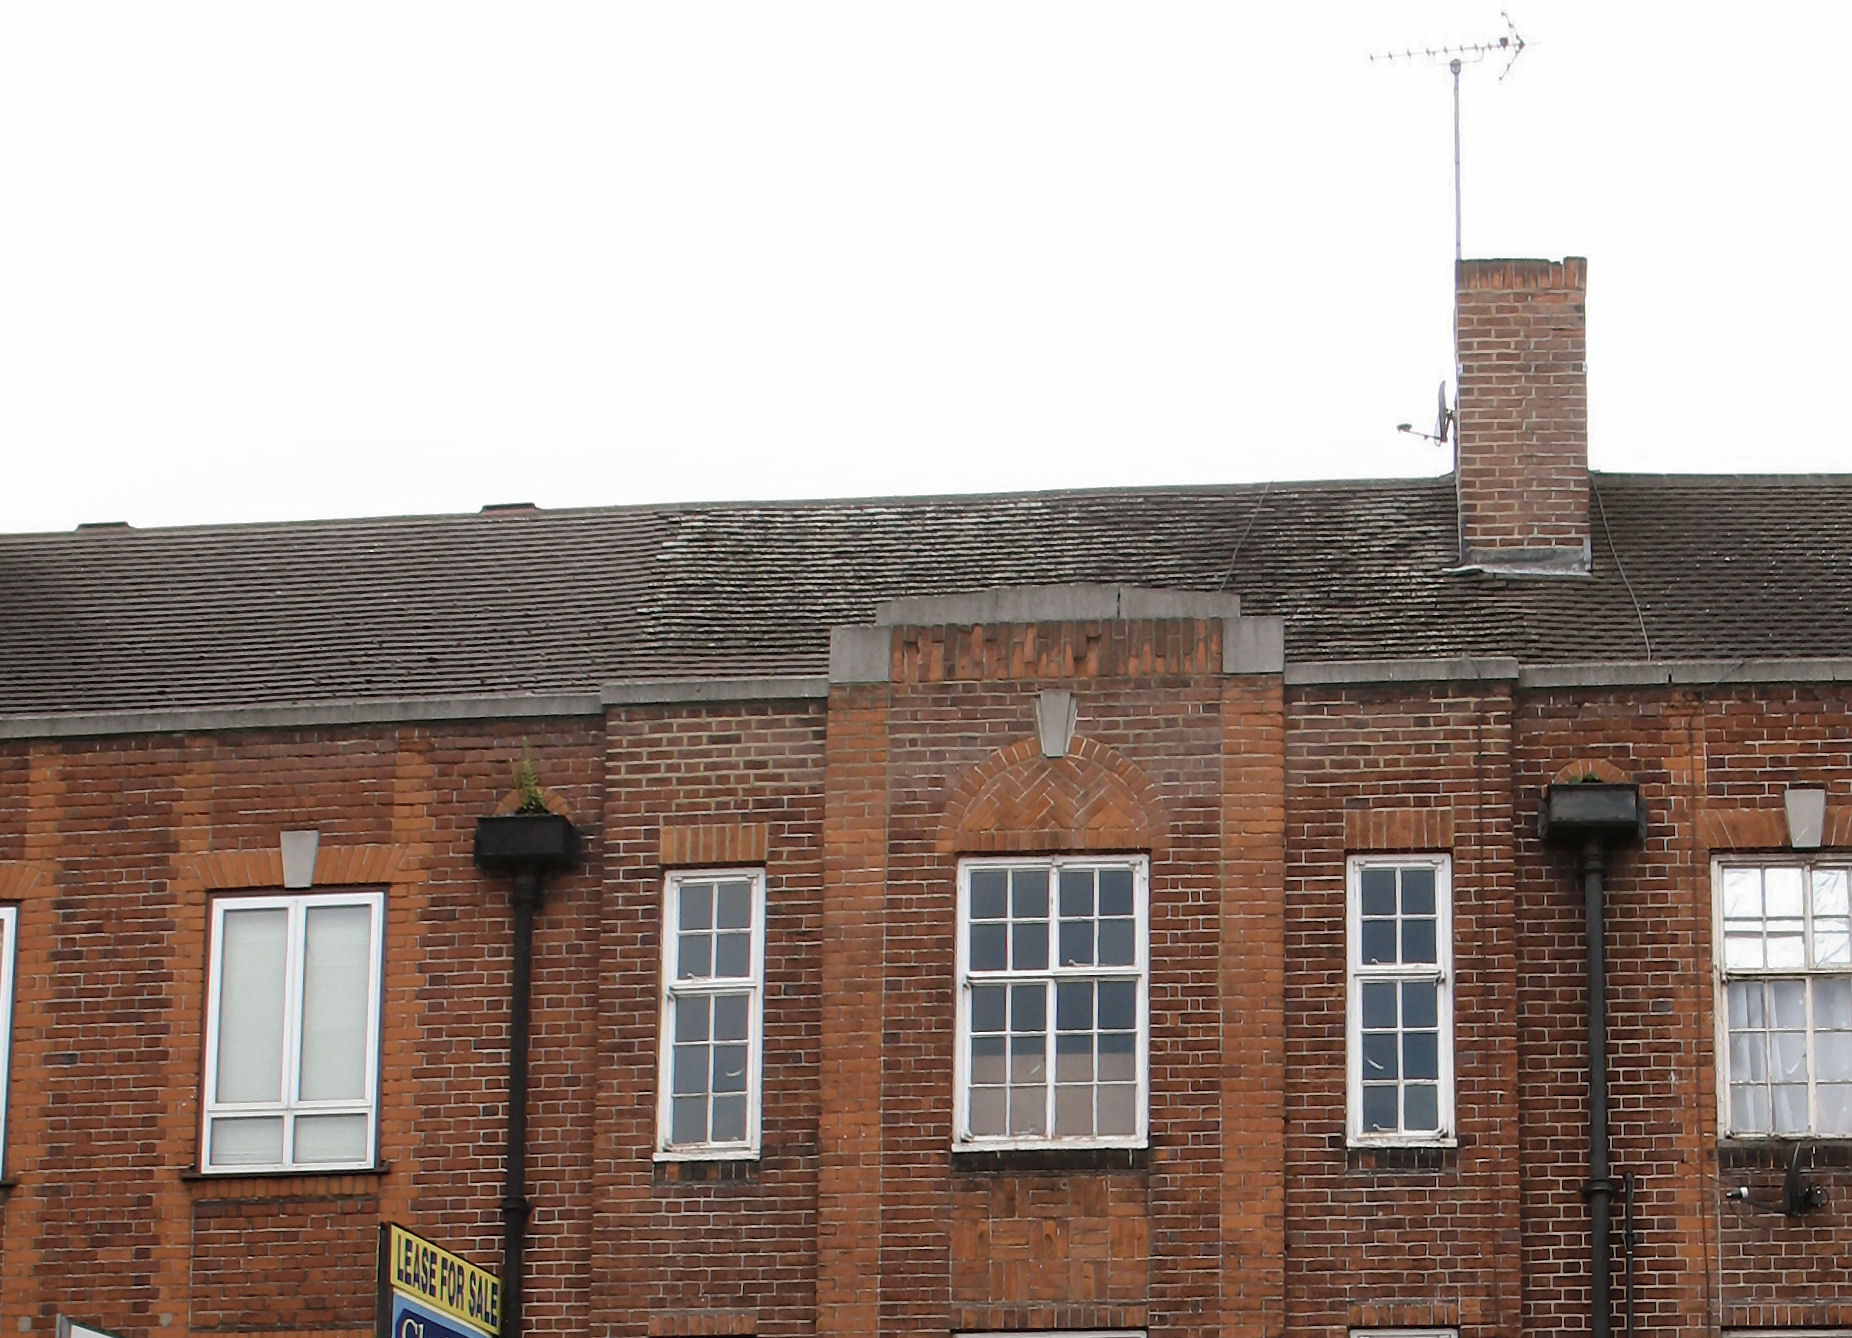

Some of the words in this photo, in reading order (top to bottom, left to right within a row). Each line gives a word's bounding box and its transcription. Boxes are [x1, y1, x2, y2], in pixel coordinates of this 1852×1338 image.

[397, 1234, 437, 1298] LEASE
[440, 1256, 465, 1311] FOR
[468, 1270, 499, 1328] SALE
